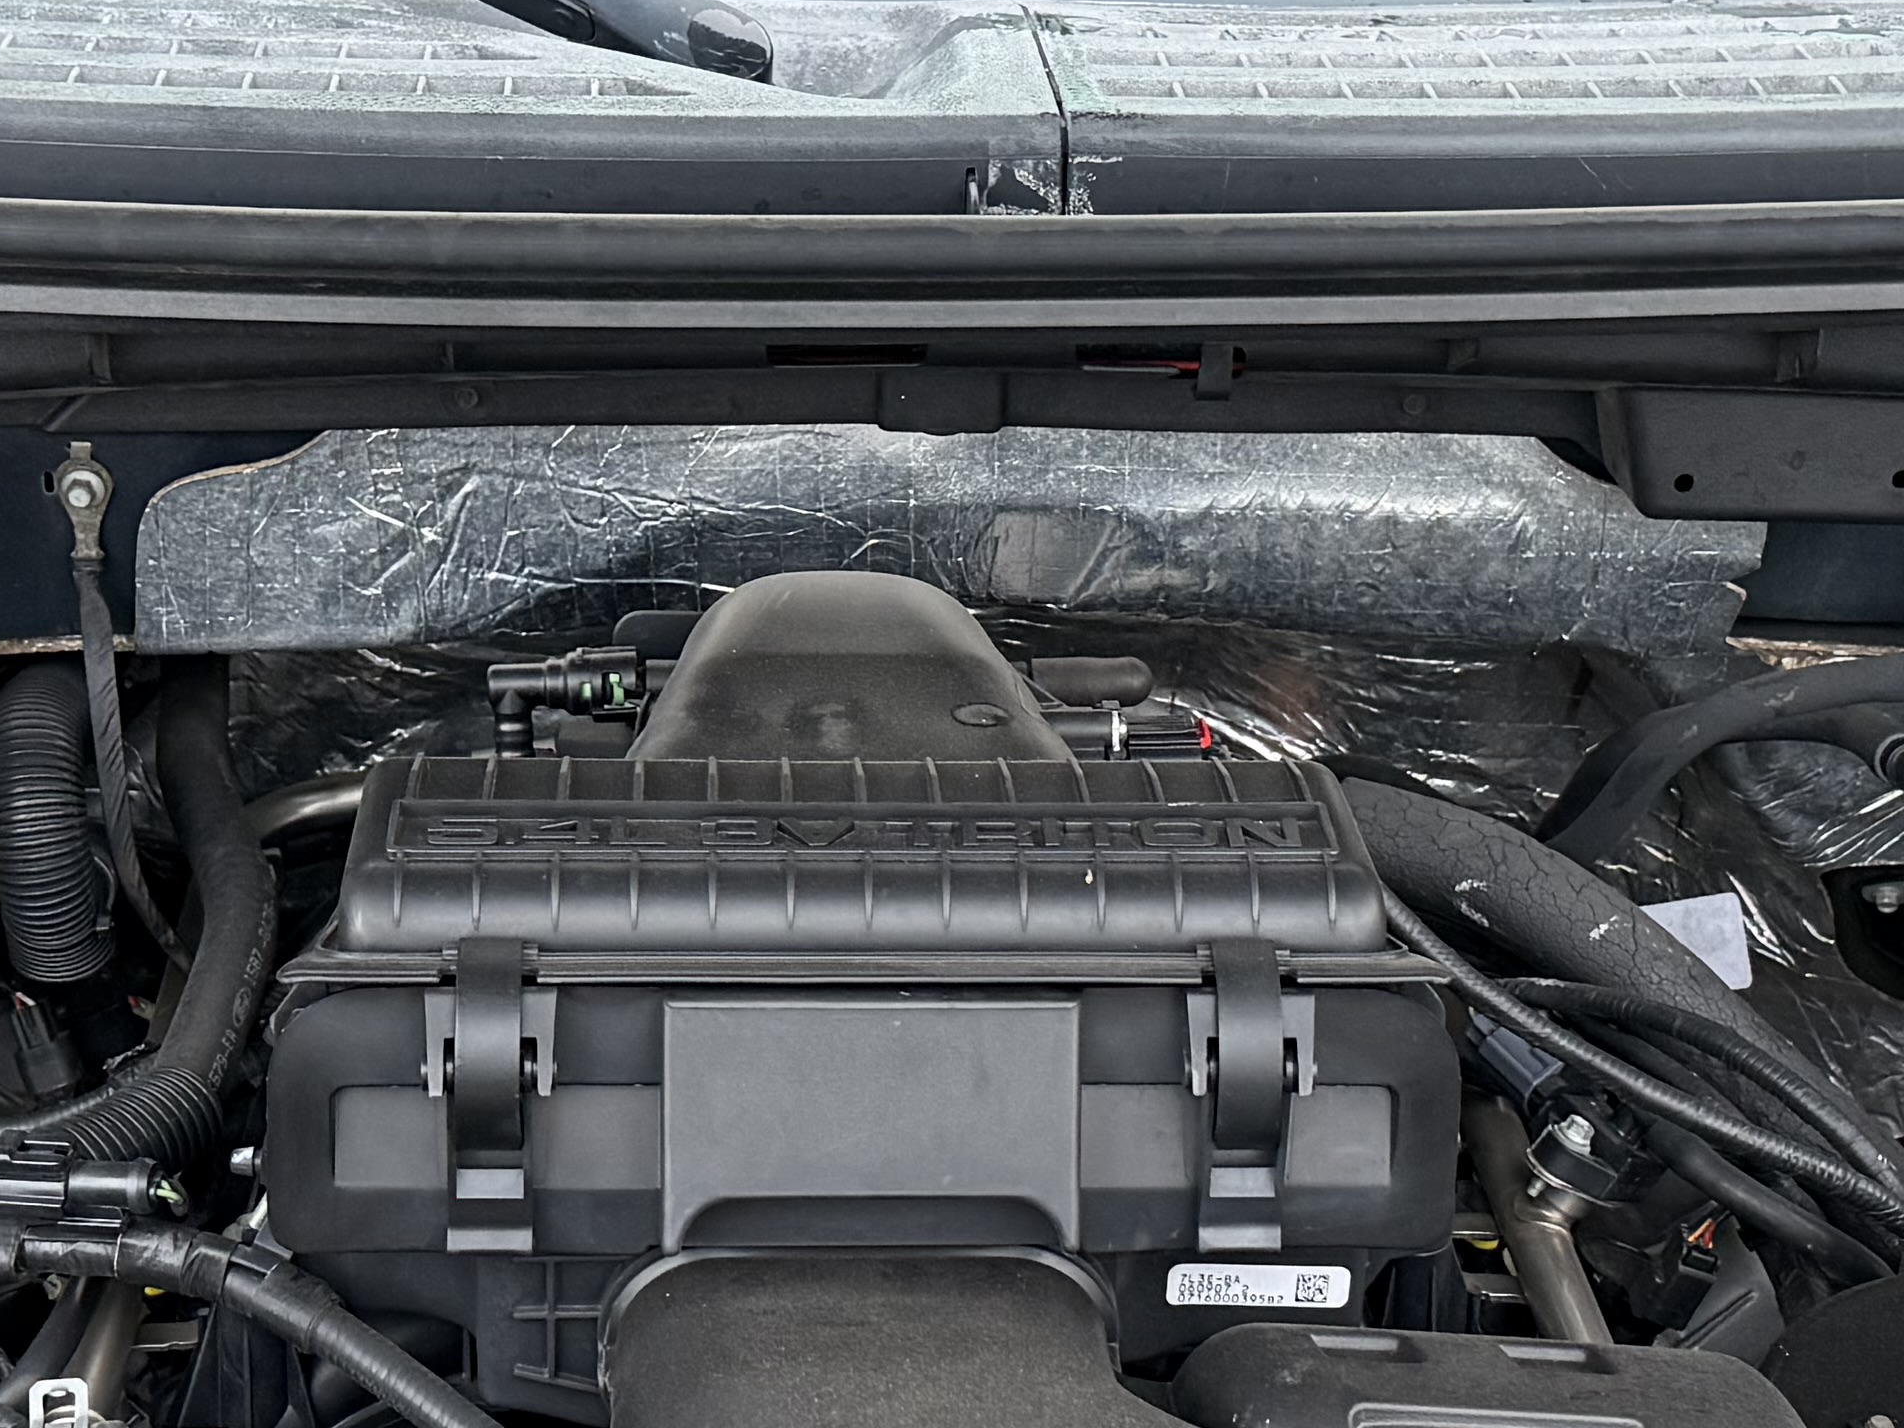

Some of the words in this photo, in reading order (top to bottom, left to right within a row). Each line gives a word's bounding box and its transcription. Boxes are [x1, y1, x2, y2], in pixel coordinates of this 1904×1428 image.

[424, 816, 668, 847] 5.4L
[700, 816, 857, 847] 3V
[868, 814, 1306, 849] TRITON
